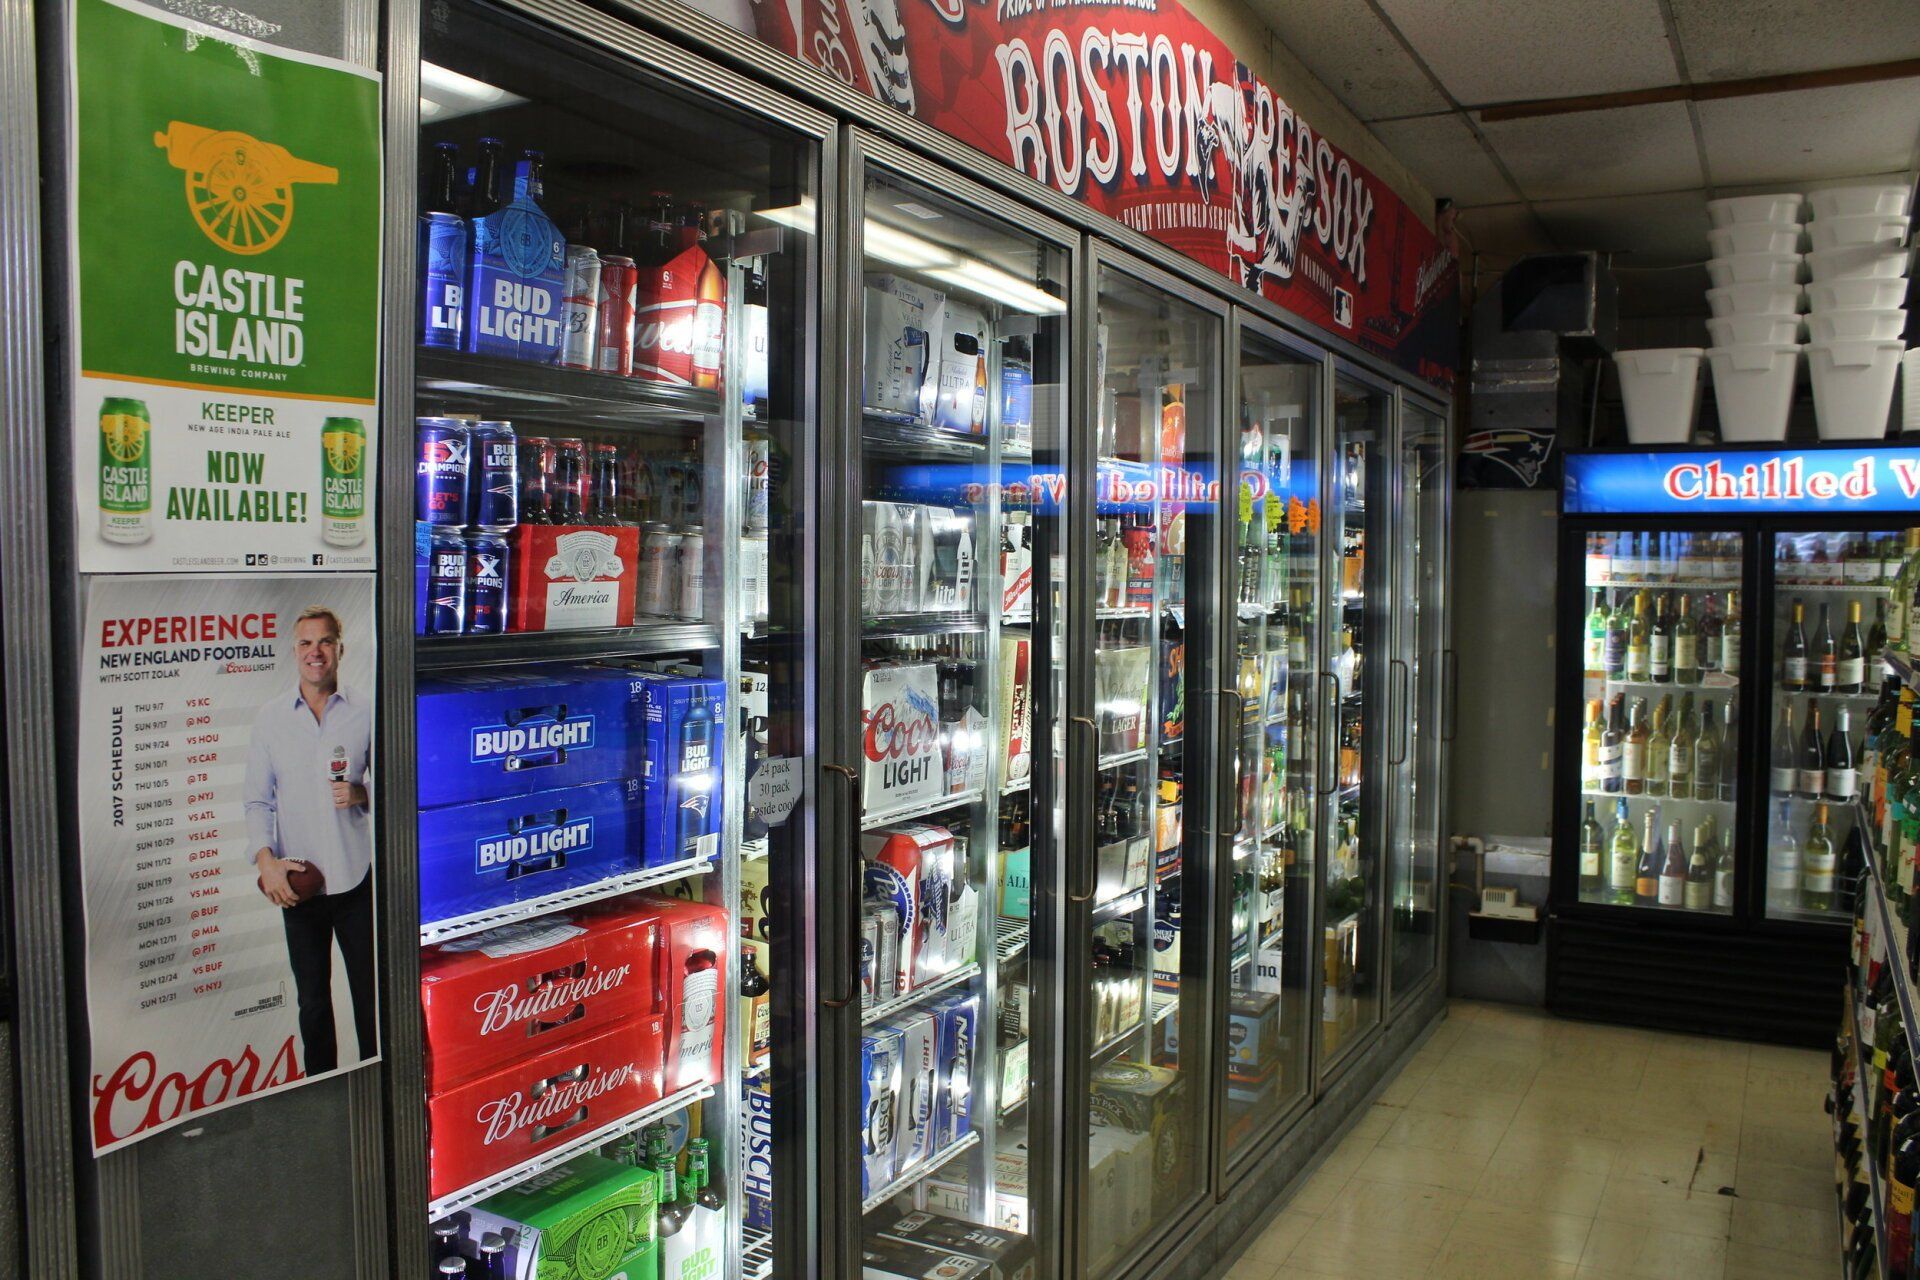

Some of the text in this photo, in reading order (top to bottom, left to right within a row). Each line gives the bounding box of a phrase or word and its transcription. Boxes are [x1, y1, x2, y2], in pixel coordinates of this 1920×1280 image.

[994, 27, 1215, 196] BOSTON
[1314, 138, 1373, 284] SOX
[1155, 203, 1178, 229] TIME
[1179, 202, 1207, 228] WORLD
[553, 241, 560, 253] 6
[662, 270, 670, 282] 6
[174, 260, 304, 321] CASTLE
[494, 278, 551, 316] BUD
[479, 305, 560, 347] LIGHT
[175, 308, 304, 367] ISLAND
[190, 363, 287, 382] BREWING COMPANY
[941, 373, 970, 389] ULTRA
[202, 402, 275, 425] KEEPER
[188, 424, 206, 432] NEW
[228, 427, 250, 436] INDIA
[253, 429, 273, 437] PALE
[423, 442, 468, 464] 5X
[102, 466, 148, 485] CASTLE
[207, 450, 265, 485] NOW
[325, 477, 362, 494] CASTLE
[1663, 456, 1878, 500] Chilled
[103, 483, 148, 503] ISLAND
[325, 493, 362, 510] ISLAND
[166, 486, 307, 524] AVAILABLE!
[552, 587, 610, 607] America
[101, 613, 277, 648] EXPERIENCE
[100, 645, 275, 669] NEW ENGLAND FOOTBALL
[100, 668, 180, 684] WITH SCOTT ZOLAK
[224, 661, 275, 674] Coors LIGHT
[629, 681, 642, 694] 18
[755, 682, 766, 692] 12
[135, 697, 210, 713] THU 9/7 VS KC
[714, 702, 721, 713] 8
[135, 716, 211, 732] SUN 9/17 @ NO
[1111, 716, 1137, 735] LAGER
[135, 734, 219, 752] SUN 9/24 VS HOU
[475, 721, 591, 757] BUD LIGHT
[685, 744, 707, 759] BUD
[754, 750, 759, 760] 6
[112, 706, 124, 827] 2017 SCHEDULE
[135, 753, 217, 772] SUN 10/1 VS CAR
[681, 756, 711, 772] LIGHT
[771, 760, 791, 778] pack
[883, 755, 932, 790] LIGHT
[135, 773, 208, 791] THU 10/5 @ TB
[626, 778, 639, 792] 18
[771, 779, 790, 798] pack
[136, 792, 214, 812] SUN 10/15 @ NYJ
[136, 811, 215, 831] SUN 10/22 VS ATL
[136, 829, 218, 851] SUN 10/29 VS LAC
[480, 823, 590, 867] BUD LIGHT
[137, 848, 218, 871] SUN 11/12 @ DEN
[137, 866, 221, 891] SUN 11/19 VS OAK
[137, 886, 220, 911] SUN 11/26 VS MIA
[138, 905, 219, 931] SUN 12/3 @ BUF
[139, 925, 220, 950] MON 12/11 @ MIA
[139, 943, 217, 969] SUN 12/17 @ PIT
[140, 961, 223, 989] SUN 12/24 VS BUF
[141, 980, 222, 1009] SUN 12/31 VS NYJ
[473, 964, 630, 1036] Budweiser
[651, 1021, 660, 1032] 18
[93, 1034, 306, 1150] Coors
[476, 1062, 635, 1146] Budweiser
[745, 1089, 772, 1201] BUSCH
[515, 1165, 575, 1195] LIGHT
[545, 1177, 584, 1196] LIME
[515, 1224, 532, 1240] 12
[964, 1231, 1007, 1249] Lite
[681, 1247, 711, 1274] BUD
